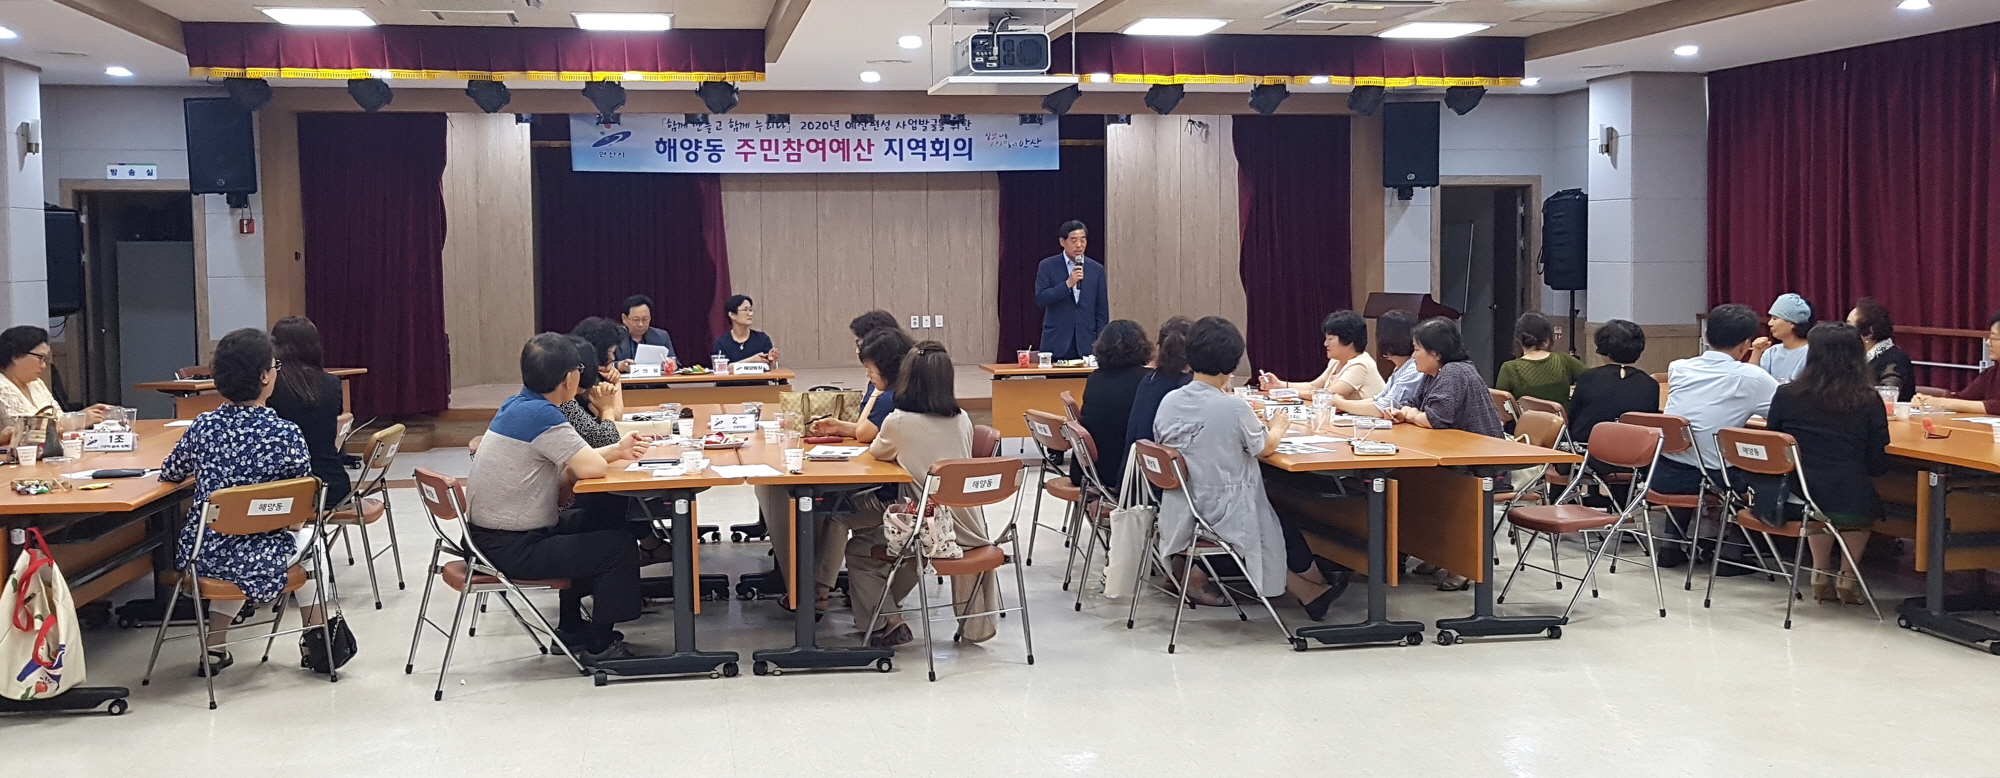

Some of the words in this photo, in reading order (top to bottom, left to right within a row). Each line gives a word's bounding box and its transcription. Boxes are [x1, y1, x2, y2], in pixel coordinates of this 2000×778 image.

[728, 118, 750, 132] 함께
[800, 119, 840, 131] 2020년
[655, 137, 726, 163] 해양동
[734, 137, 875, 163] 주민참여예산
[883, 137, 973, 162] 지역회의
[109, 434, 125, 443] 1조
